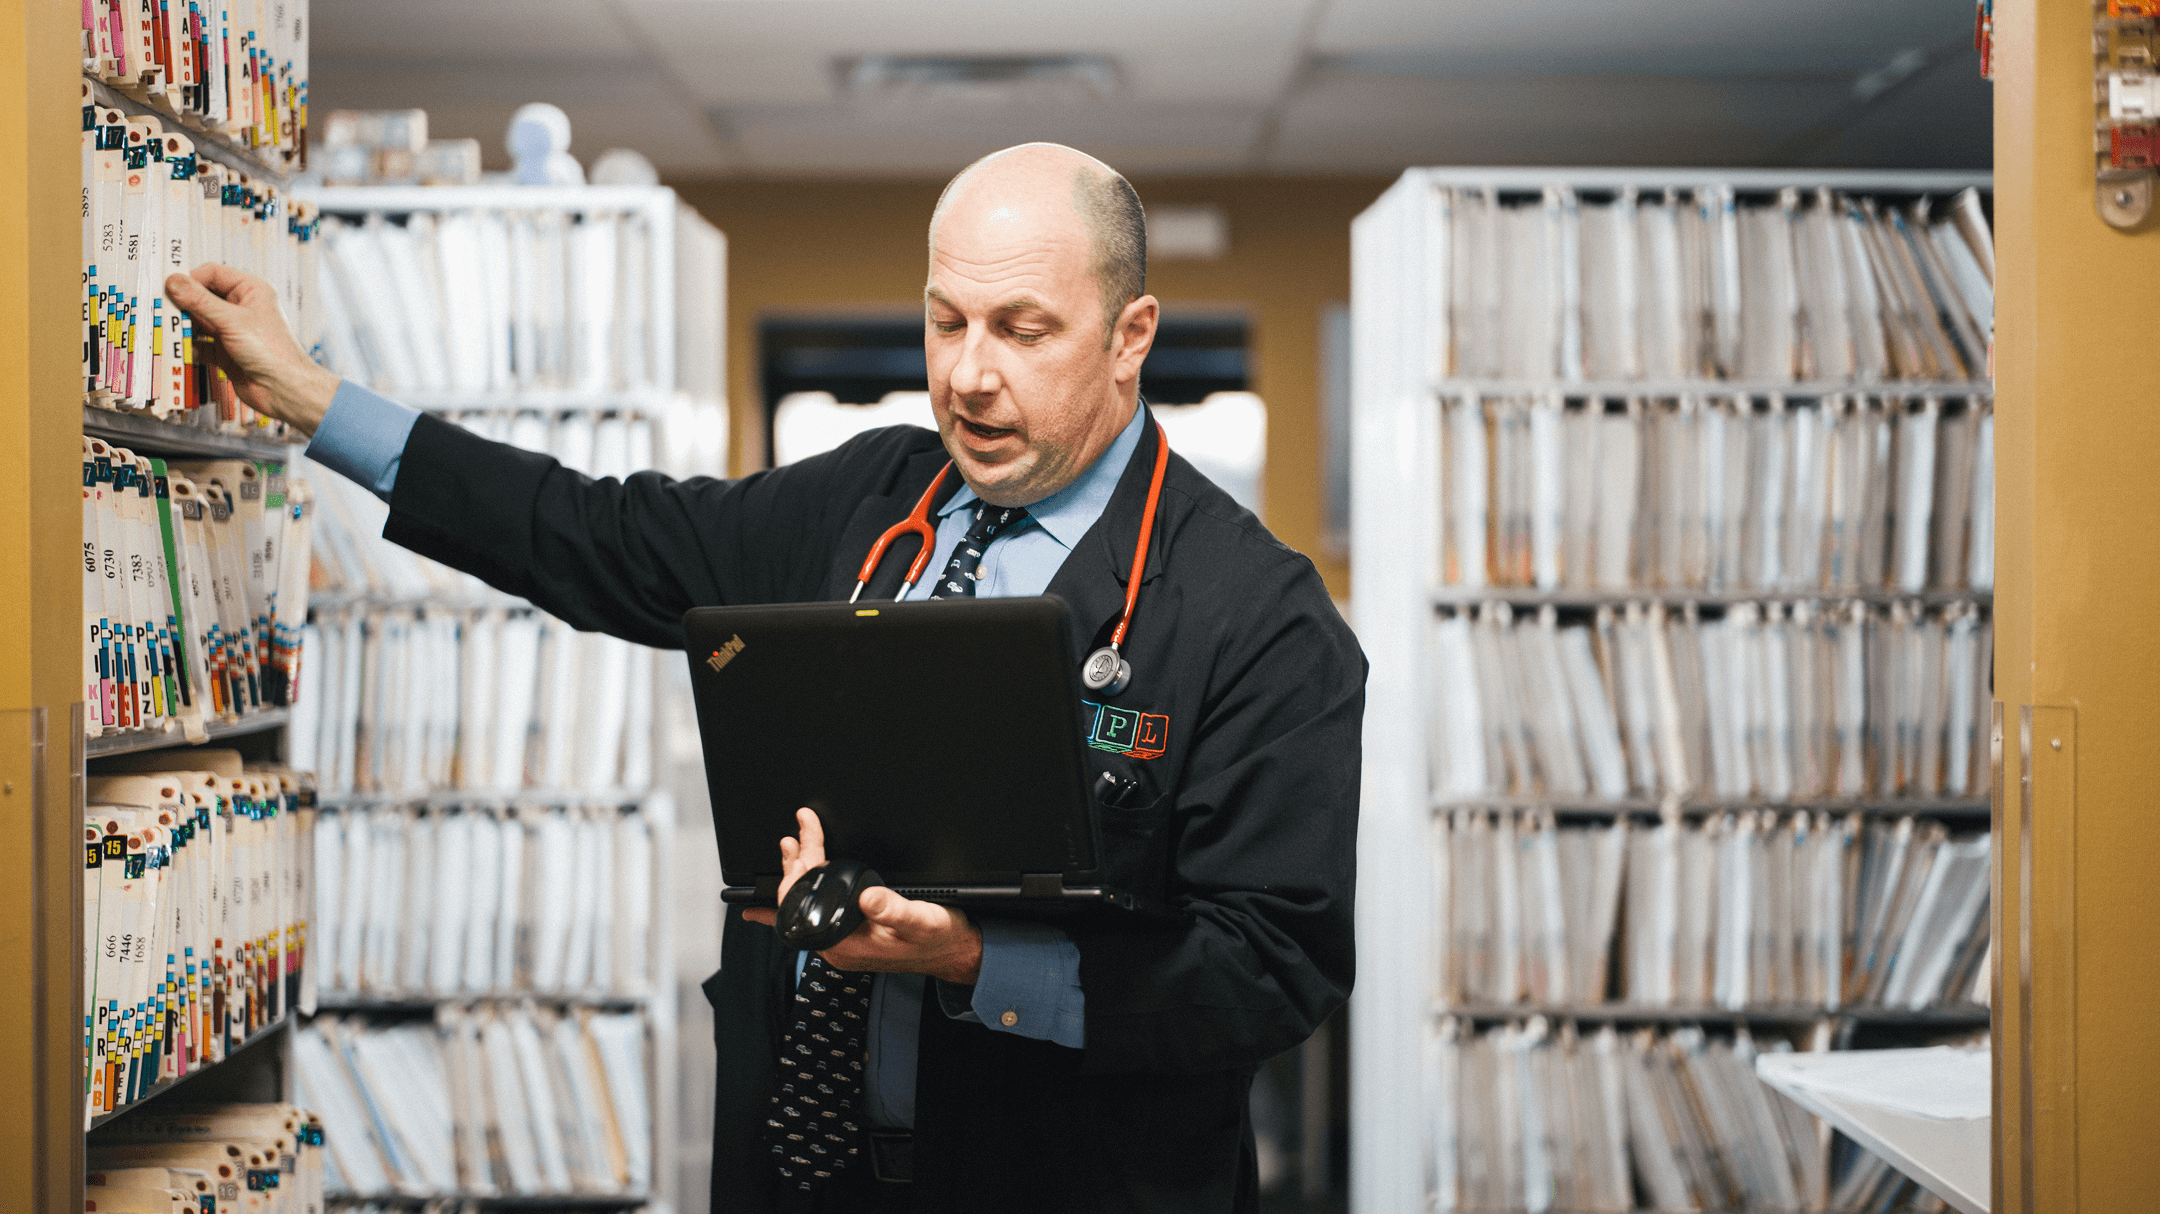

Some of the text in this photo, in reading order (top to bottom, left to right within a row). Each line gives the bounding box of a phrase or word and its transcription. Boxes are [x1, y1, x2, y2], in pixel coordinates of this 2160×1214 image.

[106, 129, 122, 146] 17
[102, 223, 114, 252] 5283
[127, 234, 139, 261] 5581
[171, 238, 182, 267] 4782
[99, 291, 107, 309] P
[122, 303, 130, 321] P
[99, 320, 106, 338] E
[171, 315, 180, 333] P
[121, 331, 128, 349] E
[173, 341, 182, 359] E
[83, 541, 97, 573] 6075
[103, 549, 116, 579] 6730
[130, 554, 144, 582] 7383
[90, 625, 99, 643] P
[136, 627, 145, 643] P
[706, 633, 746, 672] ThinkPad
[105, 840, 121, 855] 15
[126, 860, 142, 875] 17
[105, 934, 117, 958] 666
[119, 933, 133, 963] 7446
[134, 936, 147, 963] 1688
[98, 1006, 108, 1025] P
[97, 1038, 105, 1056] R
